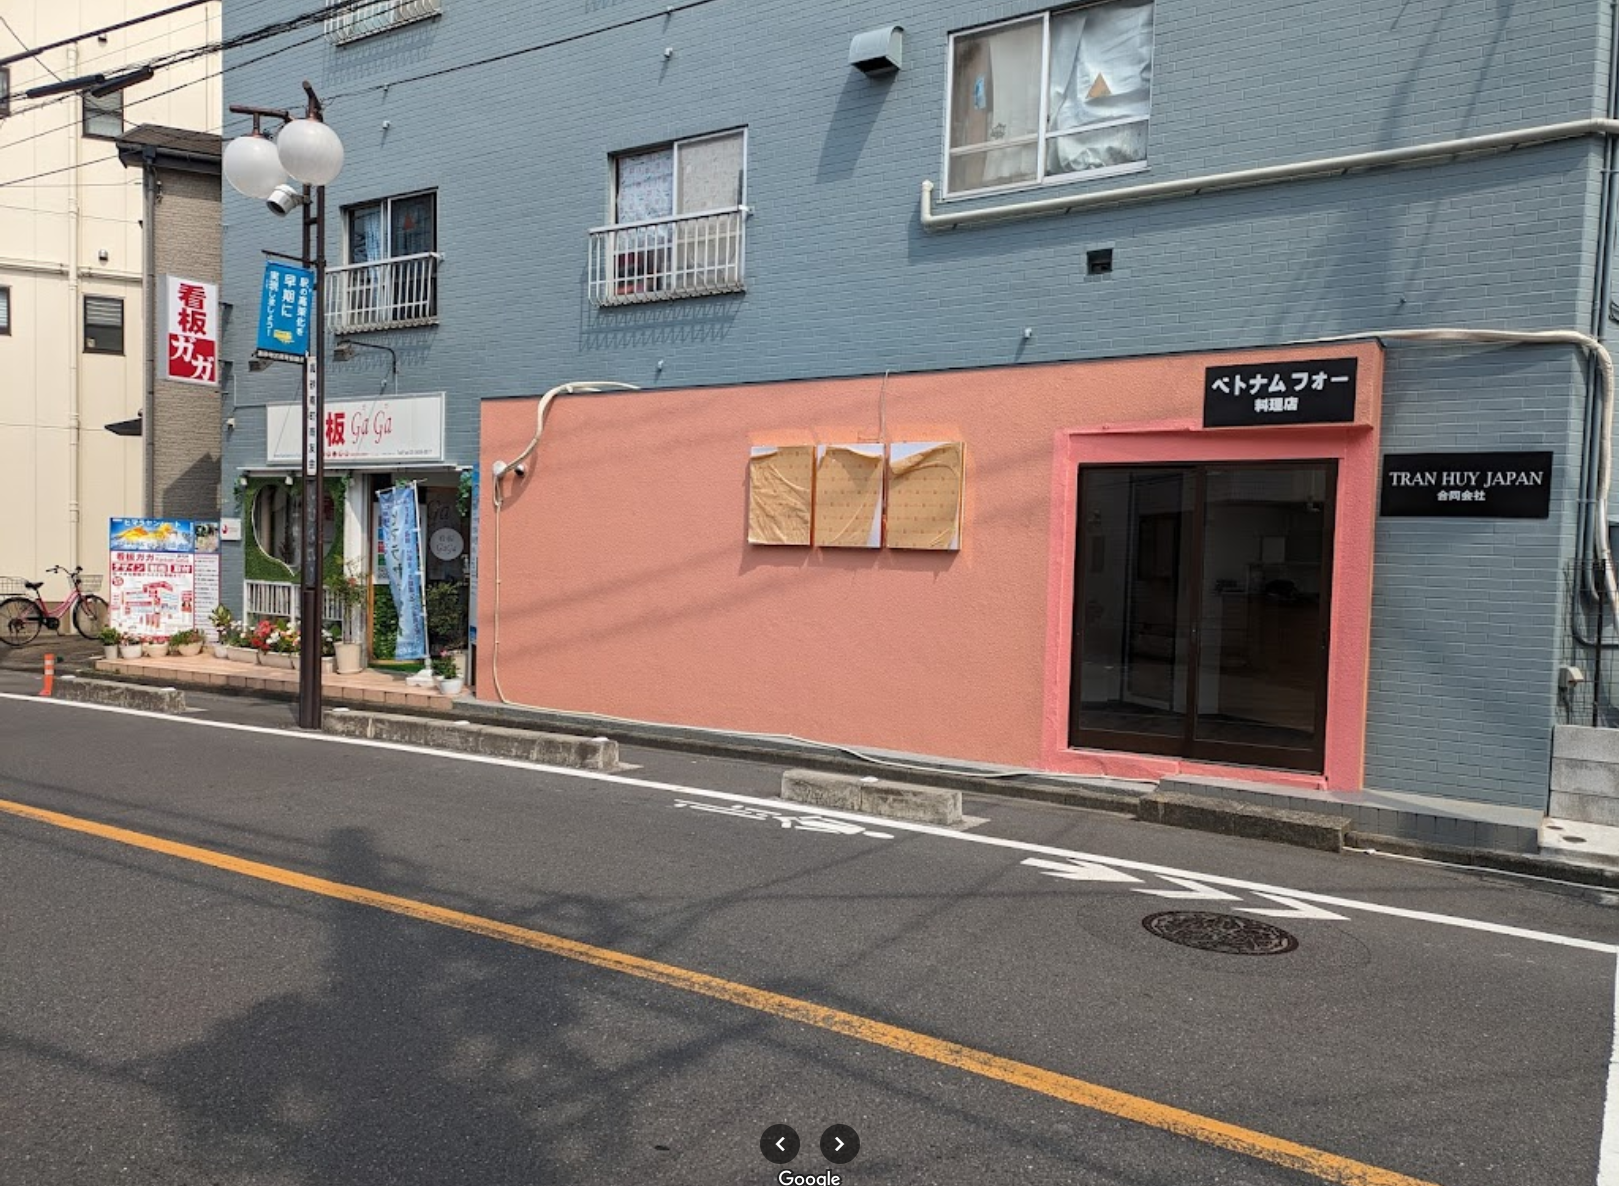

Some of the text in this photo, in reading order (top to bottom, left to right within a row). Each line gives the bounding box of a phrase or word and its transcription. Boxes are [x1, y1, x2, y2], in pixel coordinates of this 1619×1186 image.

[281, 273, 297, 318] 早期に
[1211, 371, 1349, 396] ベトナム フォー
[1254, 397, 1299, 412] 料理店
[1389, 471, 1543, 488] TRAN HUY JAPAN
[1437, 490, 1486, 501] 合同会社
